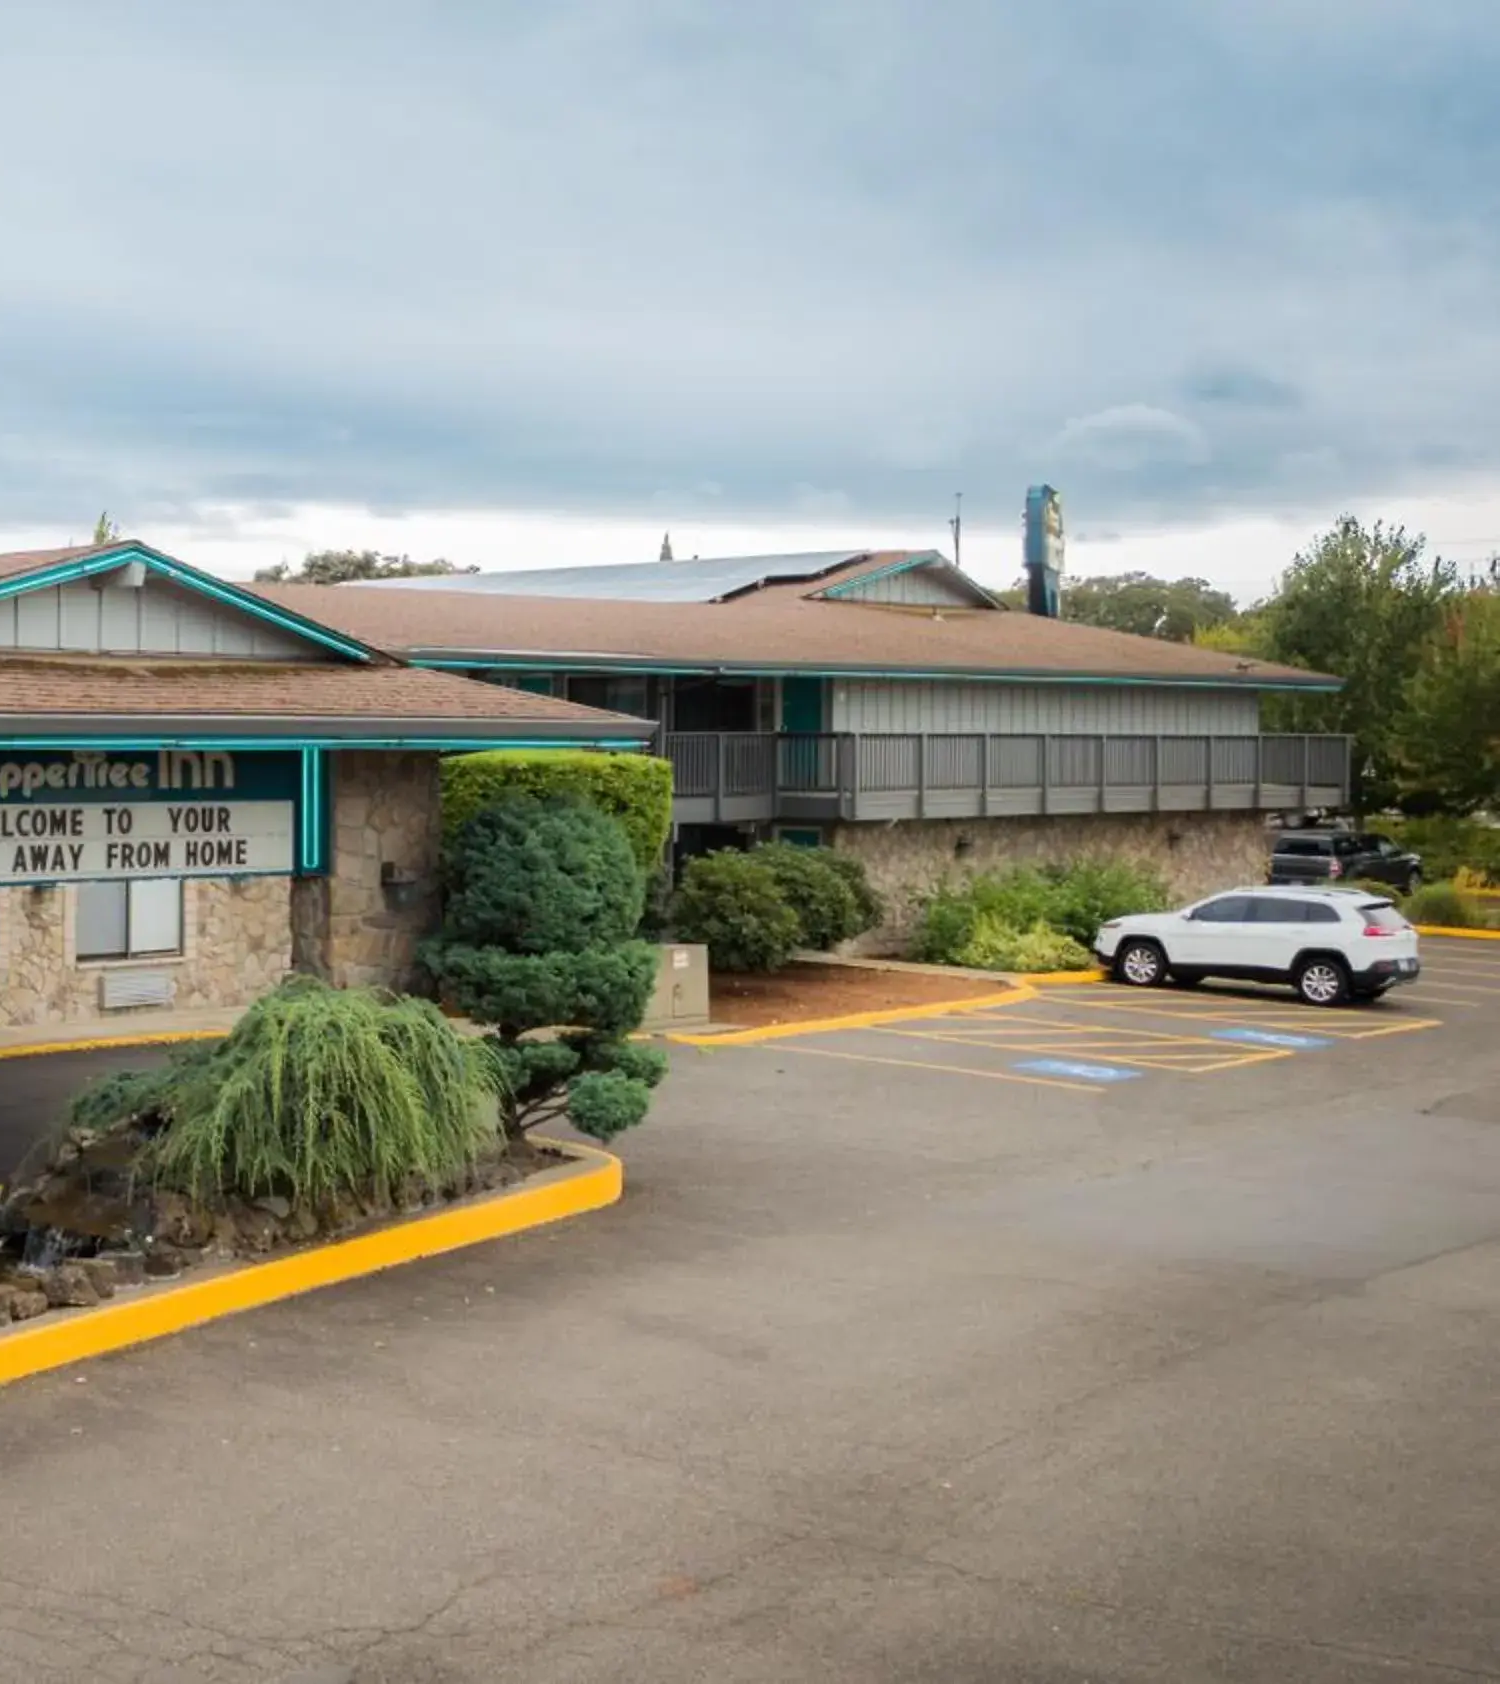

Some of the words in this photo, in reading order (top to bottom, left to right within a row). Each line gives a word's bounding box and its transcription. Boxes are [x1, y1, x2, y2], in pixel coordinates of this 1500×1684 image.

[158, 749, 235, 789] Inn
[102, 808, 133, 834] TO
[167, 806, 231, 833] YOUR
[12, 843, 84, 872] AWAY
[106, 841, 171, 869] FROM
[185, 839, 248, 866] HOME
